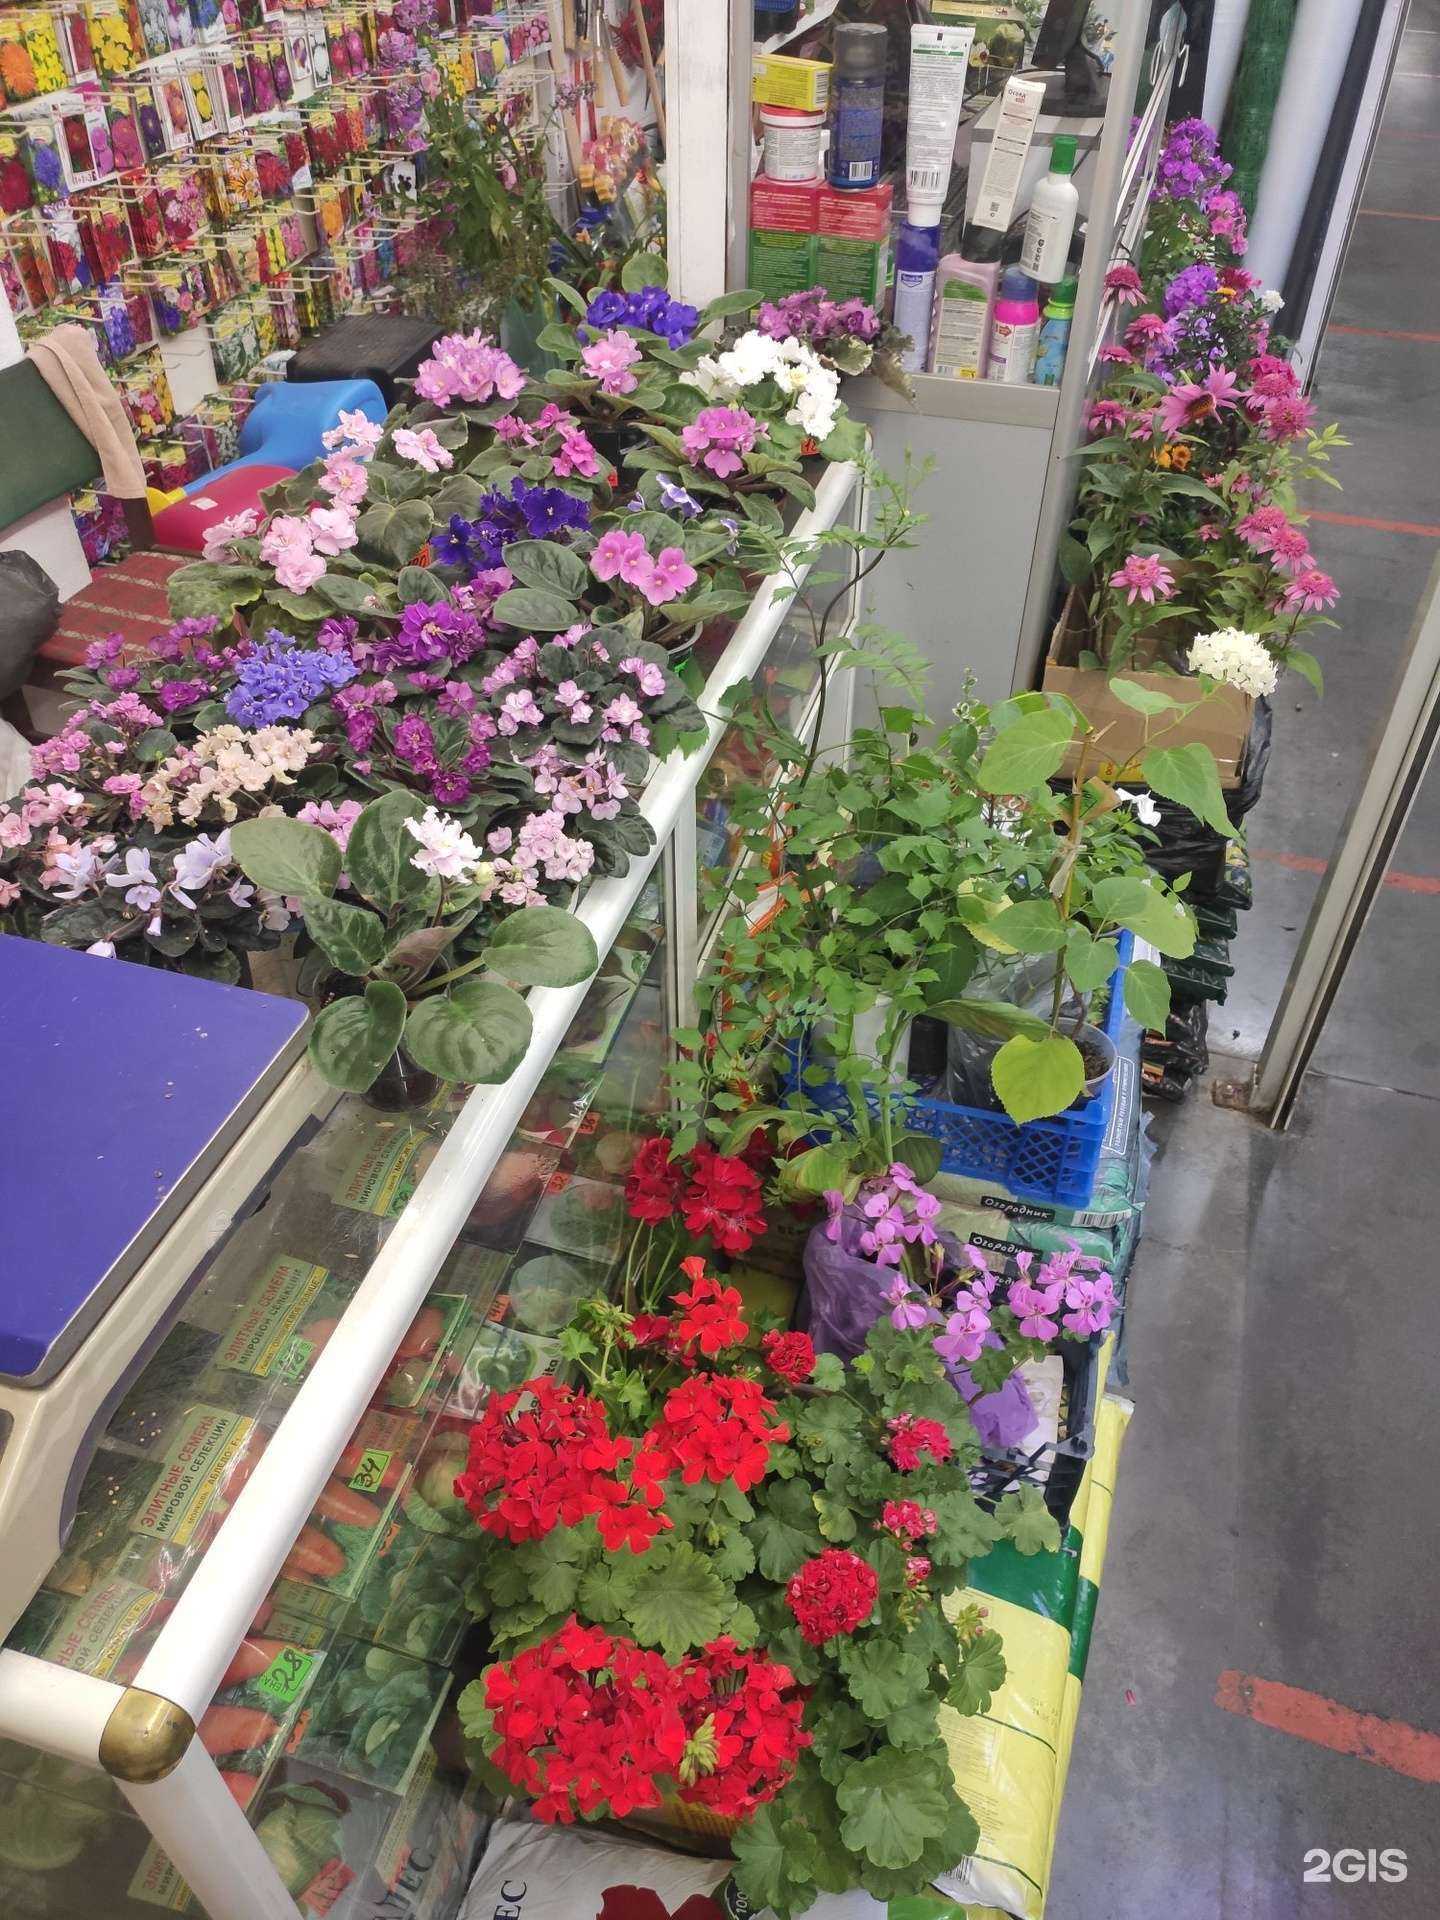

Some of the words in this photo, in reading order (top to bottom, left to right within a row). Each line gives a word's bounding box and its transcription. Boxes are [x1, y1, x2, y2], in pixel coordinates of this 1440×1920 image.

[985, 1198, 1049, 1219] Огородник
[973, 1237, 1030, 1257] Огородн
[224, 1307, 264, 1361] ЭЛИТНЫЕ
[260, 1265, 290, 1307] СЕМЕНА
[140, 1464, 185, 1528] ЭЛИТНЫЕ
[178, 1416, 219, 1463] СЕМЕНА
[156, 1475, 194, 1532] МИРОВОЙ
[190, 1418, 230, 1472] СЕЛЕКЦИИ
[494, 1880, 527, 1920] ЕС
